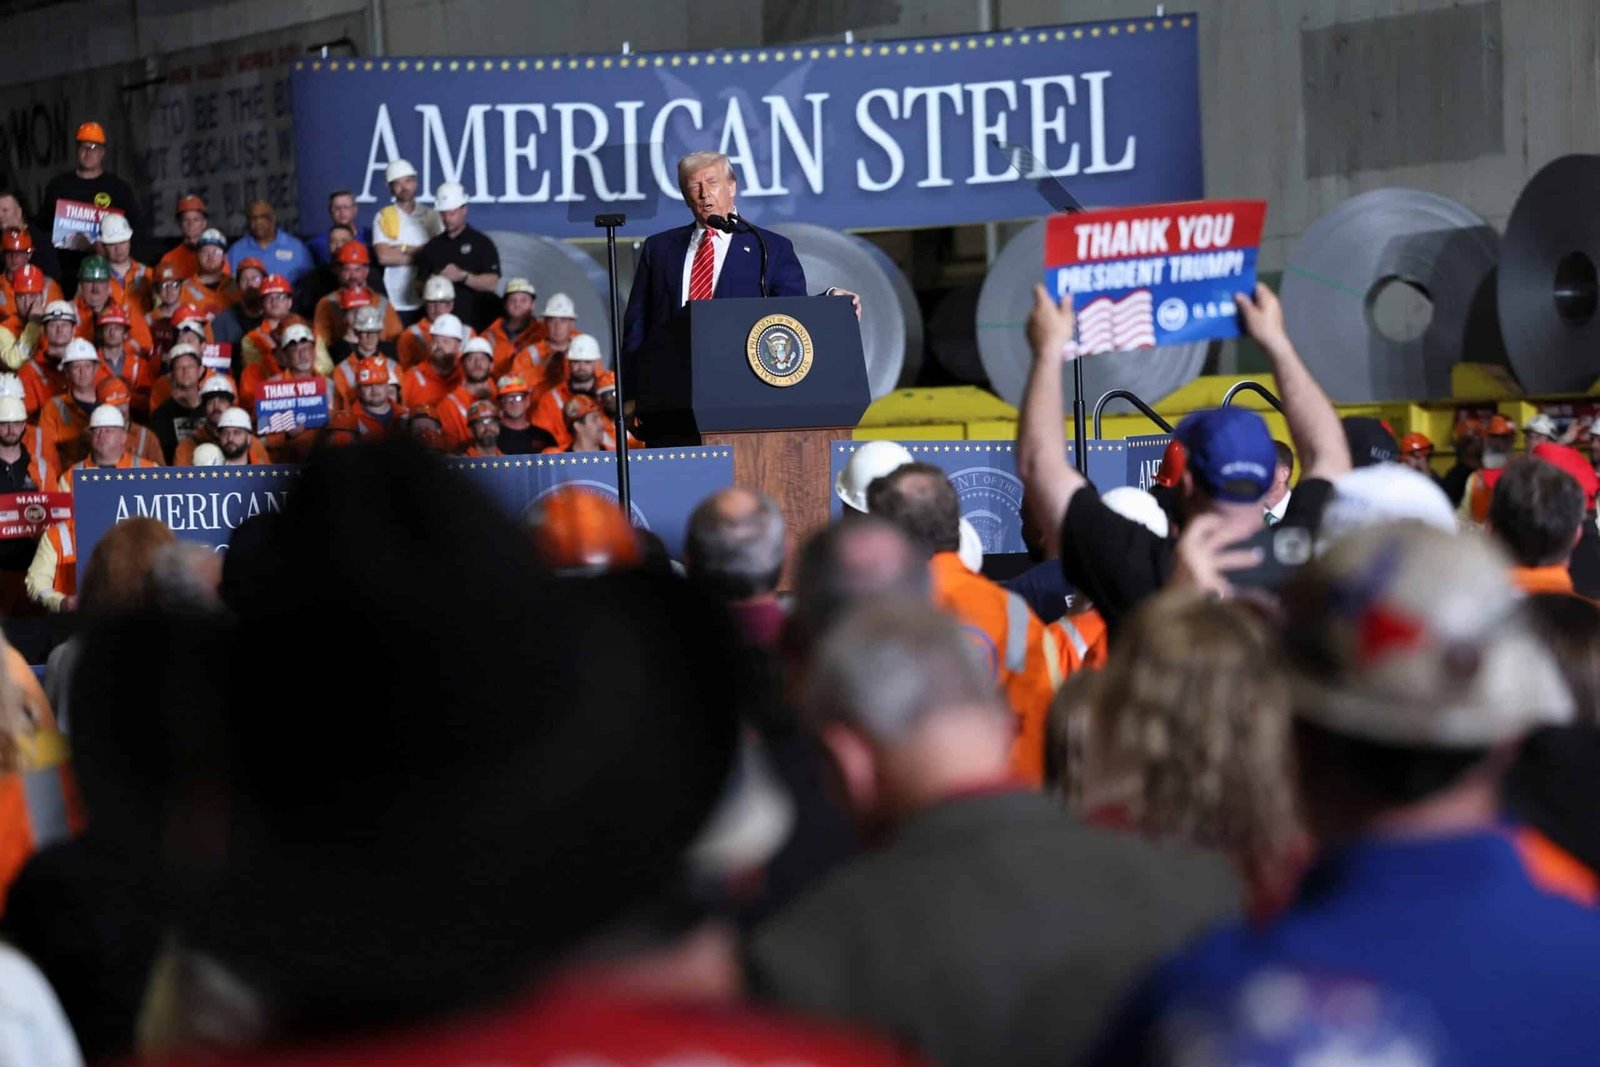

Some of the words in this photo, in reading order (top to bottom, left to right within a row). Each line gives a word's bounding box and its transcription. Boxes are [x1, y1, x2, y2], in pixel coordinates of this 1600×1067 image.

[355, 92, 830, 204] AMERICAN
[855, 70, 1137, 192] STEEL
[66, 204, 96, 222] THANK
[1074, 215, 1171, 260] THANK
[1177, 212, 1235, 250] YOU
[1057, 256, 1166, 297] PRESIDENT
[1168, 249, 1245, 284] TRUMP!
[749, 318, 776, 350] PRESIDENT
[795, 324, 812, 354] UNITED
[760, 369, 777, 383] SEAL
[788, 360, 810, 383] STATES
[263, 382, 296, 399] THANK
[296, 381, 317, 396] YOU
[983, 474, 996, 484] OF
[999, 478, 1018, 495] THE
[16, 494, 49, 504] MAKE
[2, 525, 37, 535] GREAT
